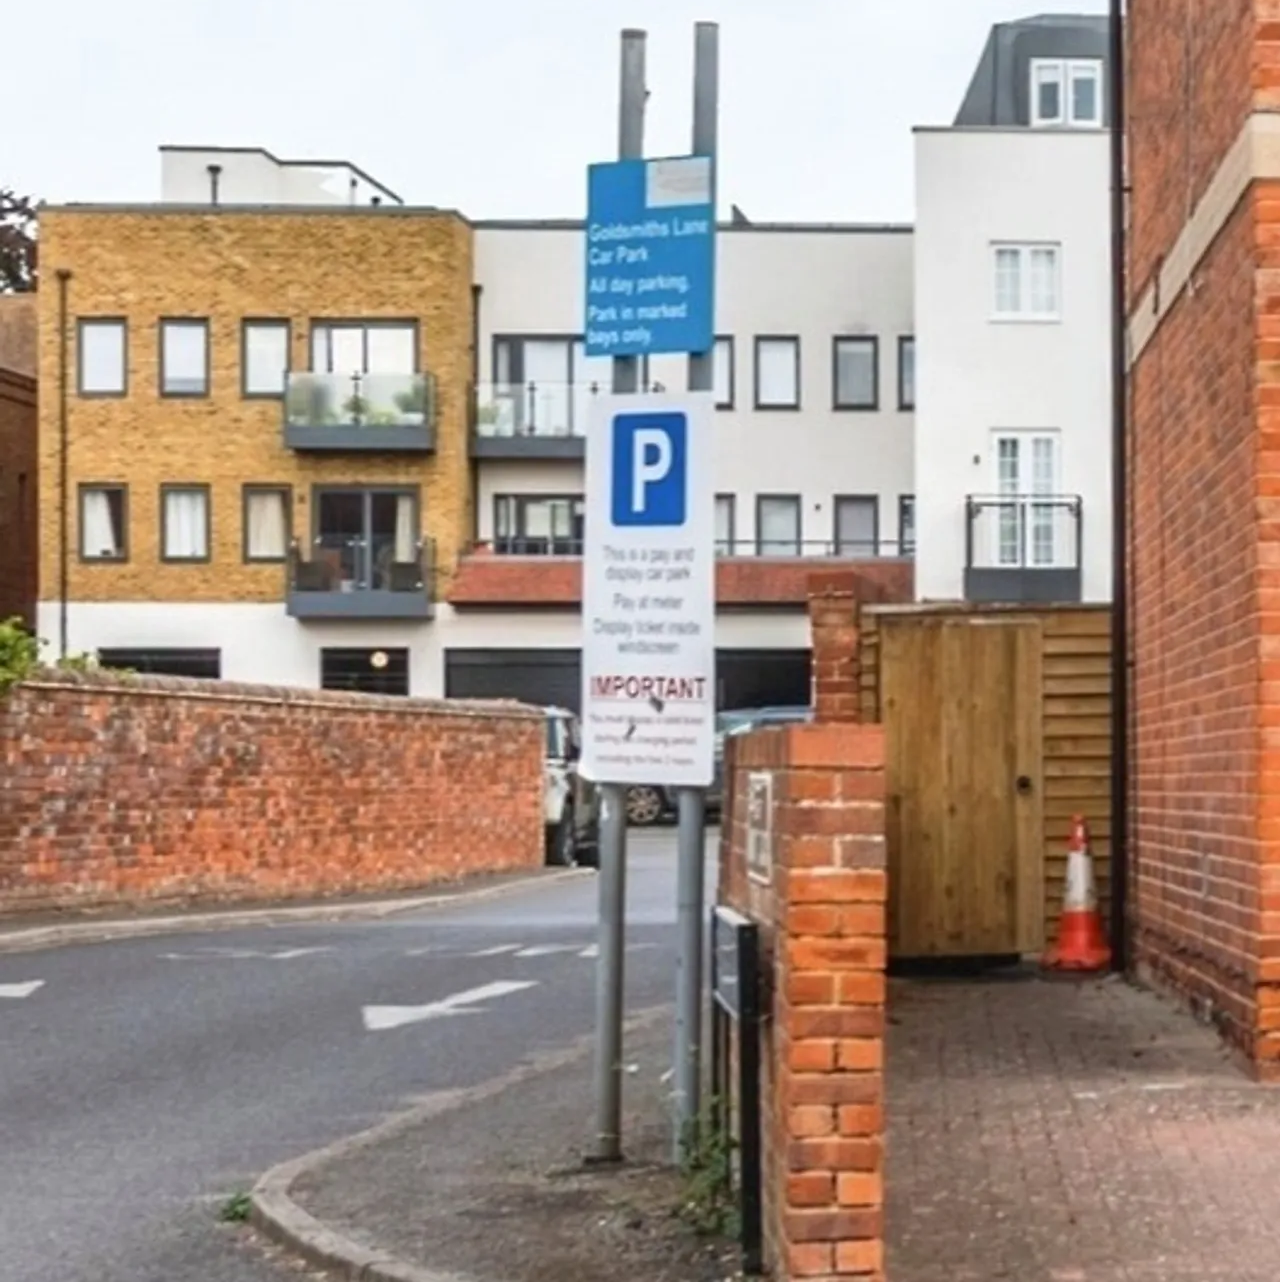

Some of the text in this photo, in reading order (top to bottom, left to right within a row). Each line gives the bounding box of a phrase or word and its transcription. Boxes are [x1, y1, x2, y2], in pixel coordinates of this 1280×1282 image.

[589, 217, 708, 241] Goldsmiths Lane
[589, 246, 648, 265] Car Park
[589, 276, 606, 293] All
[610, 276, 633, 295] day
[588, 302, 688, 321] Park in marked
[587, 329, 618, 347] bays
[631, 429, 673, 512] P
[602, 545, 625, 561] This
[650, 548, 670, 565] pay
[674, 546, 695, 562] and
[605, 566, 691, 584] display car park
[613, 591, 635, 612] Pay
[592, 617, 633, 639] Display
[589, 675, 706, 699] IMPORTANT
